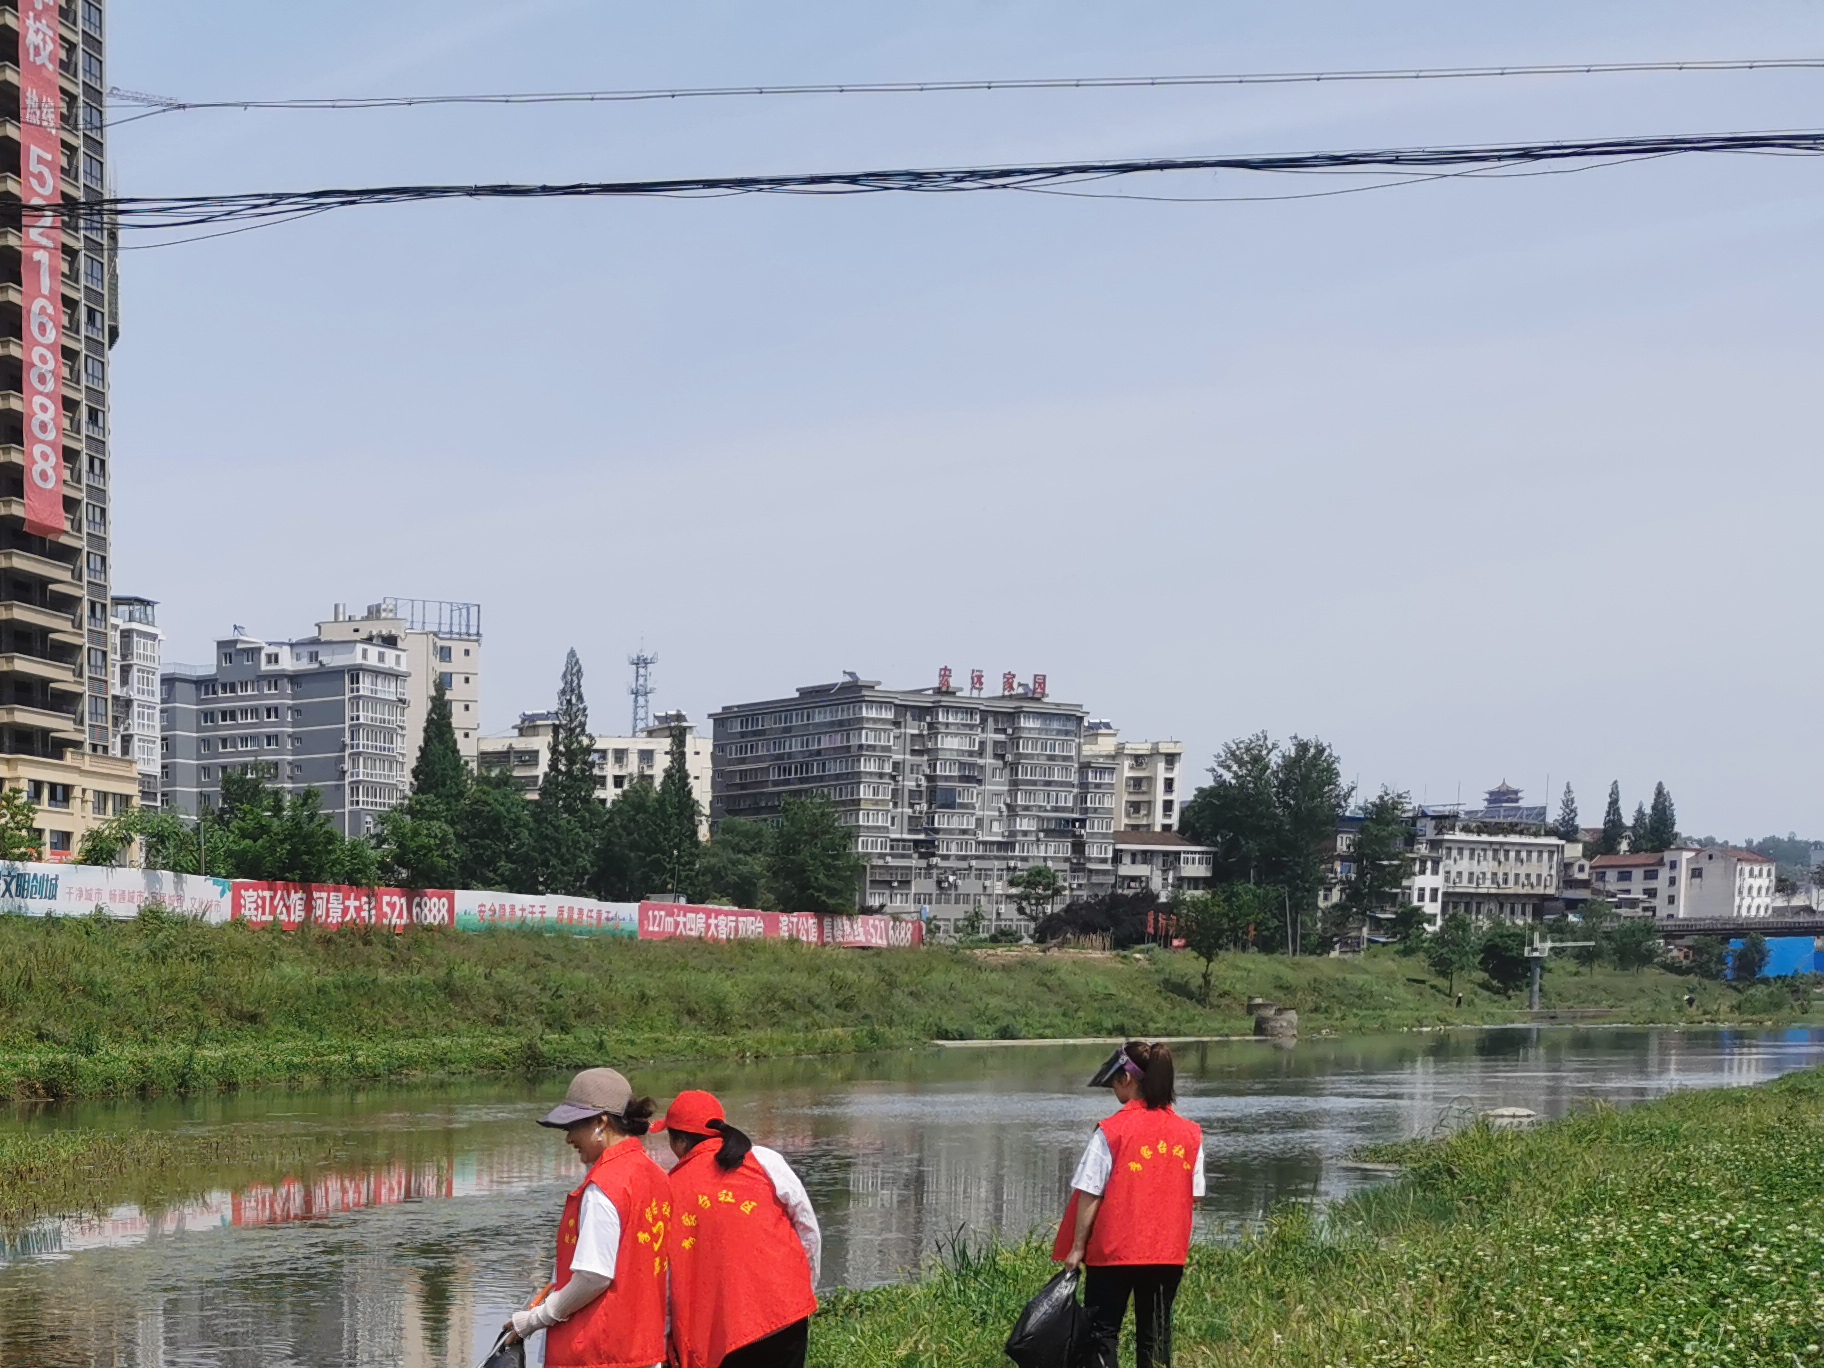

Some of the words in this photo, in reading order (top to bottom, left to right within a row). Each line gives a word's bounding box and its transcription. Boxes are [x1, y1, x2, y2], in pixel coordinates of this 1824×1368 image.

[25, 0, 55, 71] 校
[29, 144, 57, 490] 5216888
[240, 888, 306, 923] 滨江公馆
[382, 895, 409, 926] 521
[412, 896, 449, 926] 6888
